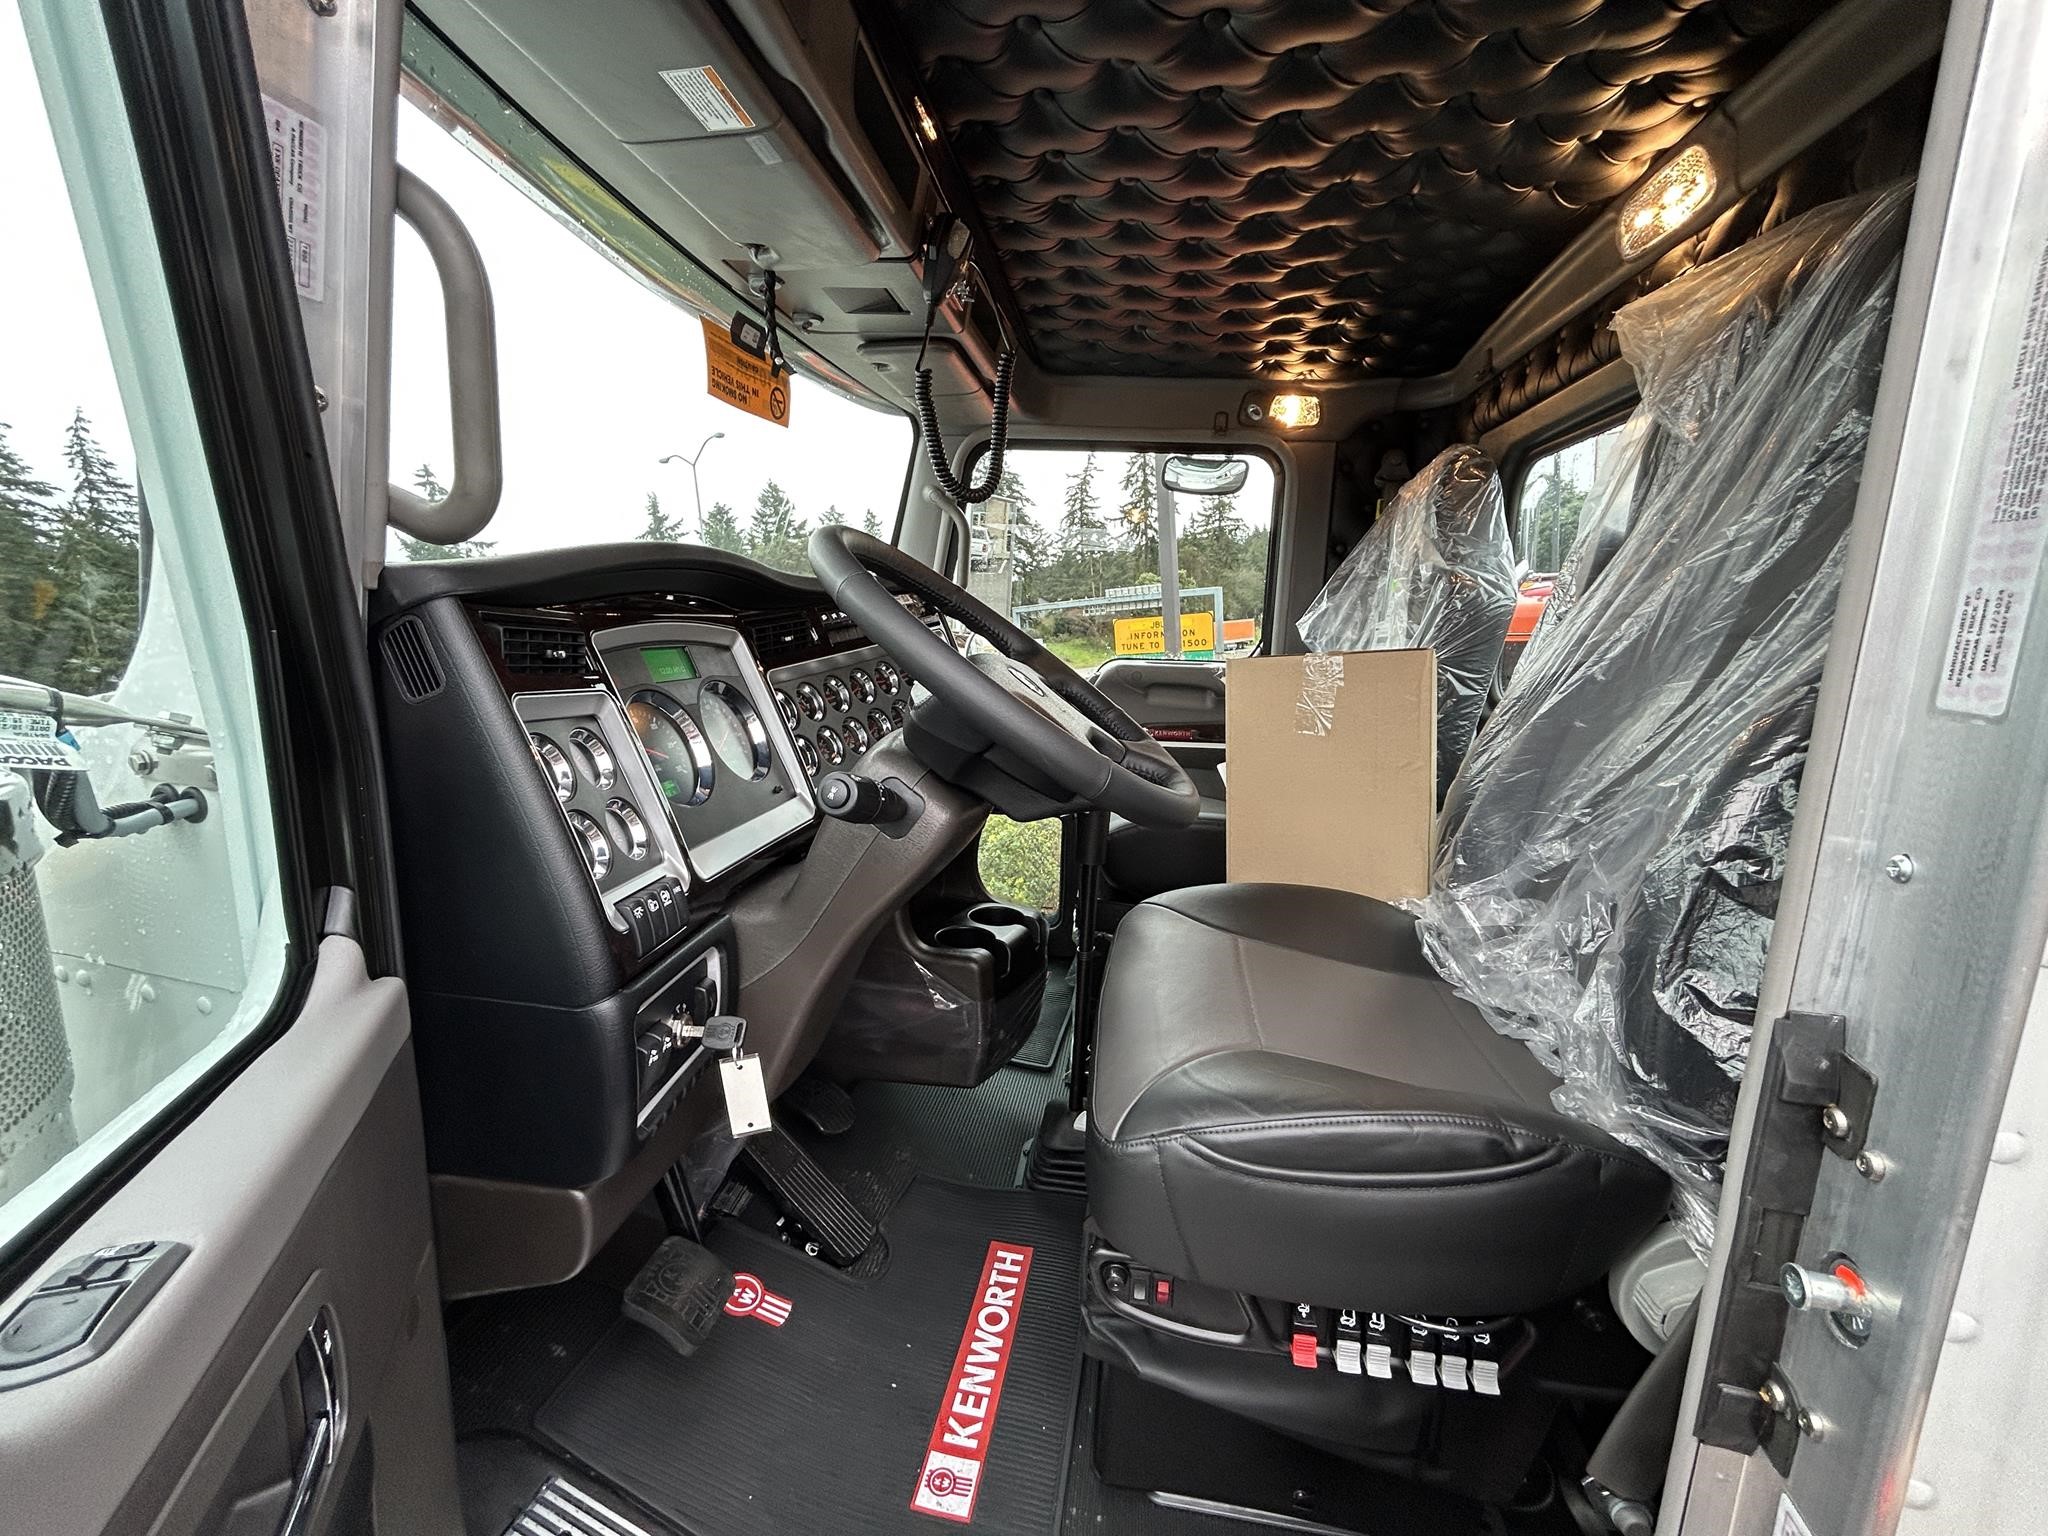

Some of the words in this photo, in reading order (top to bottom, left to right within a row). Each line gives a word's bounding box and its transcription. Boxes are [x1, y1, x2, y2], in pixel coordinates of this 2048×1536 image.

[712, 366, 734, 386] VEHICLE
[736, 380, 750, 394] THIS
[712, 378, 737, 399] SMOKING
[738, 392, 747, 405] NO
[752, 388, 759, 398] IN
[2015, 450, 2027, 489] REMOVAL
[1122, 642, 1144, 650] TUNE
[1183, 639, 1207, 647] 1500
[1948, 608, 1968, 680] MANUFACTURED
[1964, 594, 1971, 606] BY
[1956, 639, 1970, 687] KENWORTH
[1968, 605, 1978, 633] TRUCK
[1976, 587, 1982, 600] CO
[1969, 638, 1980, 670] PACCAR
[1977, 598, 1989, 636] Company
[1981, 644, 1991, 671] DATE:
[943, 1249, 1024, 1449] KENWORTH
